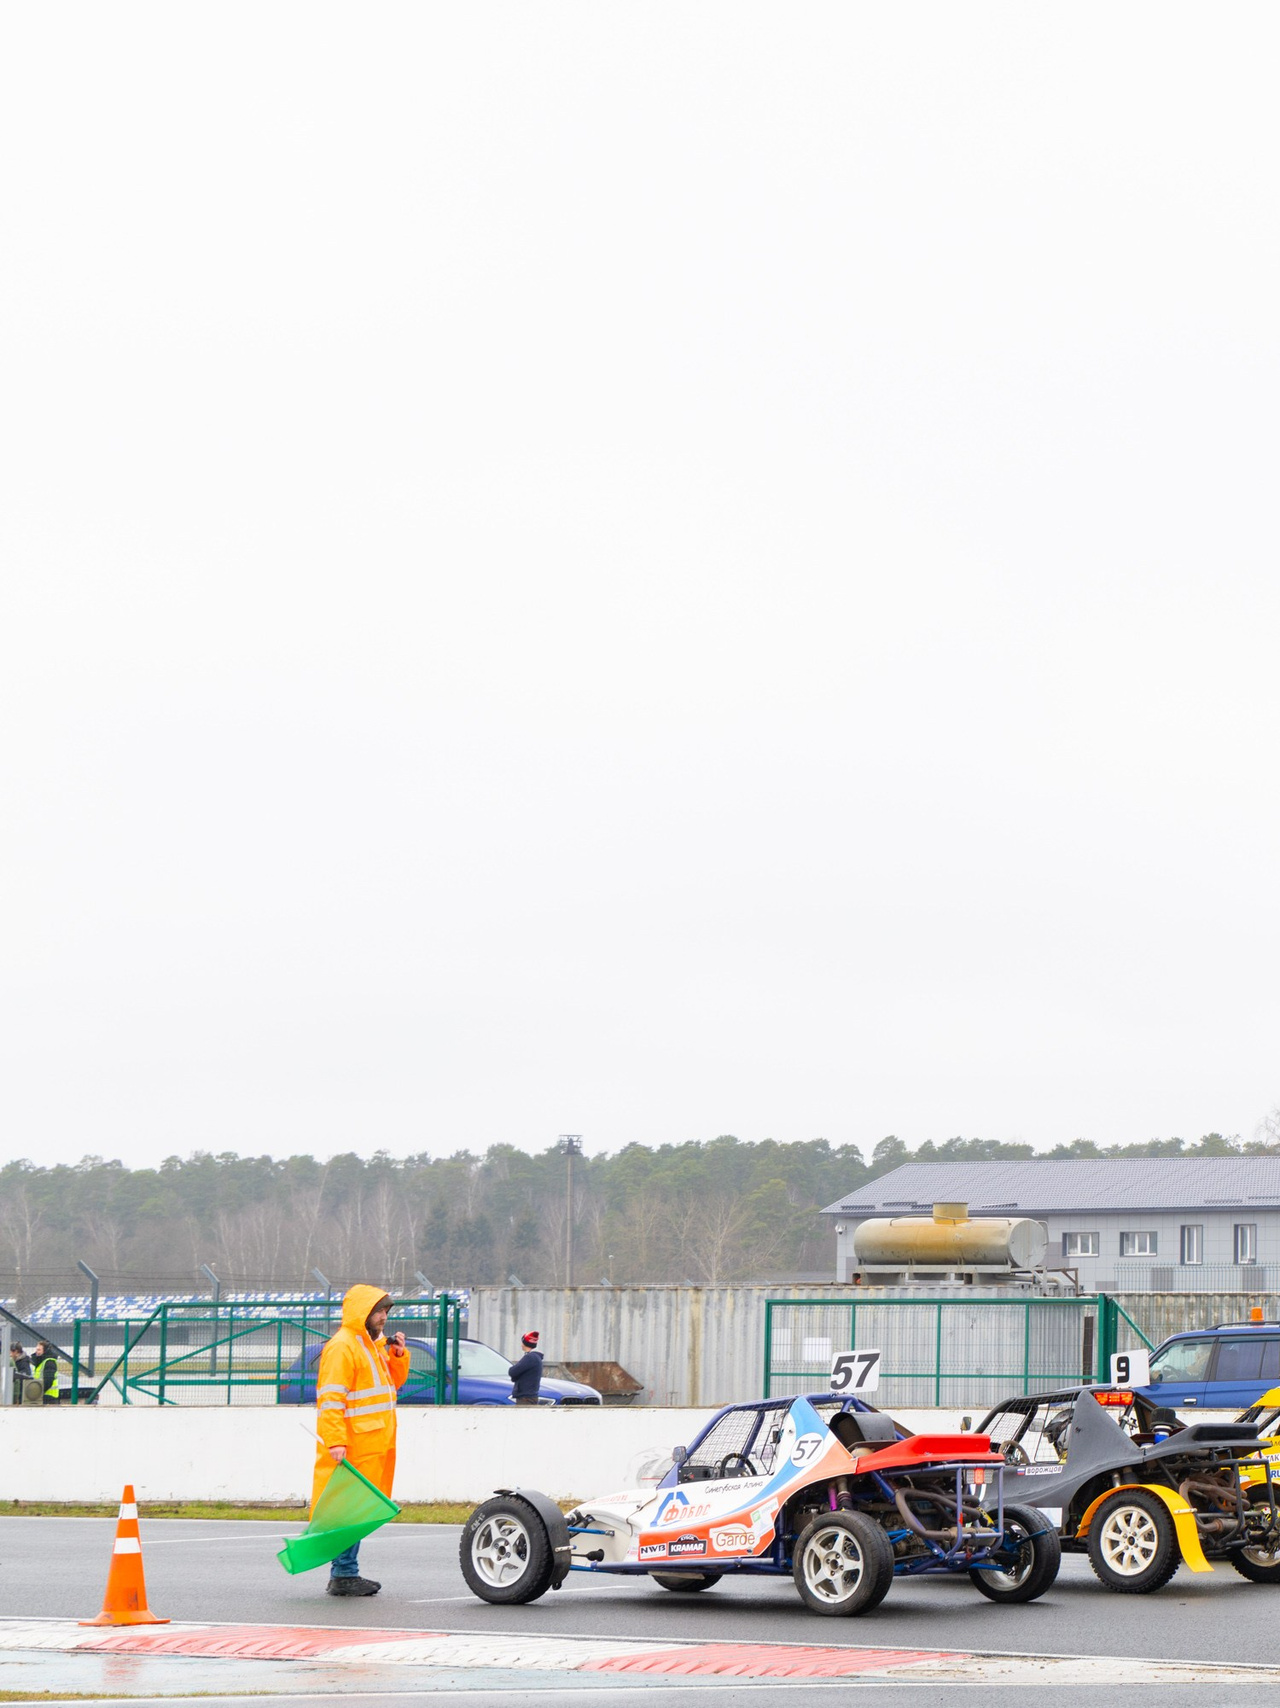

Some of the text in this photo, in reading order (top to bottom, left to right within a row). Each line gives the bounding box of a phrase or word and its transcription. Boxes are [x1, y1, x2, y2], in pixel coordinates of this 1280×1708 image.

[830, 1352, 881, 1390] 57
[1116, 1356, 1130, 1384] 9
[792, 1440, 822, 1461] 57
[670, 1543, 705, 1553] KRAMAR
[715, 1531, 756, 1547] Garde
[640, 1544, 666, 1554] NWB
